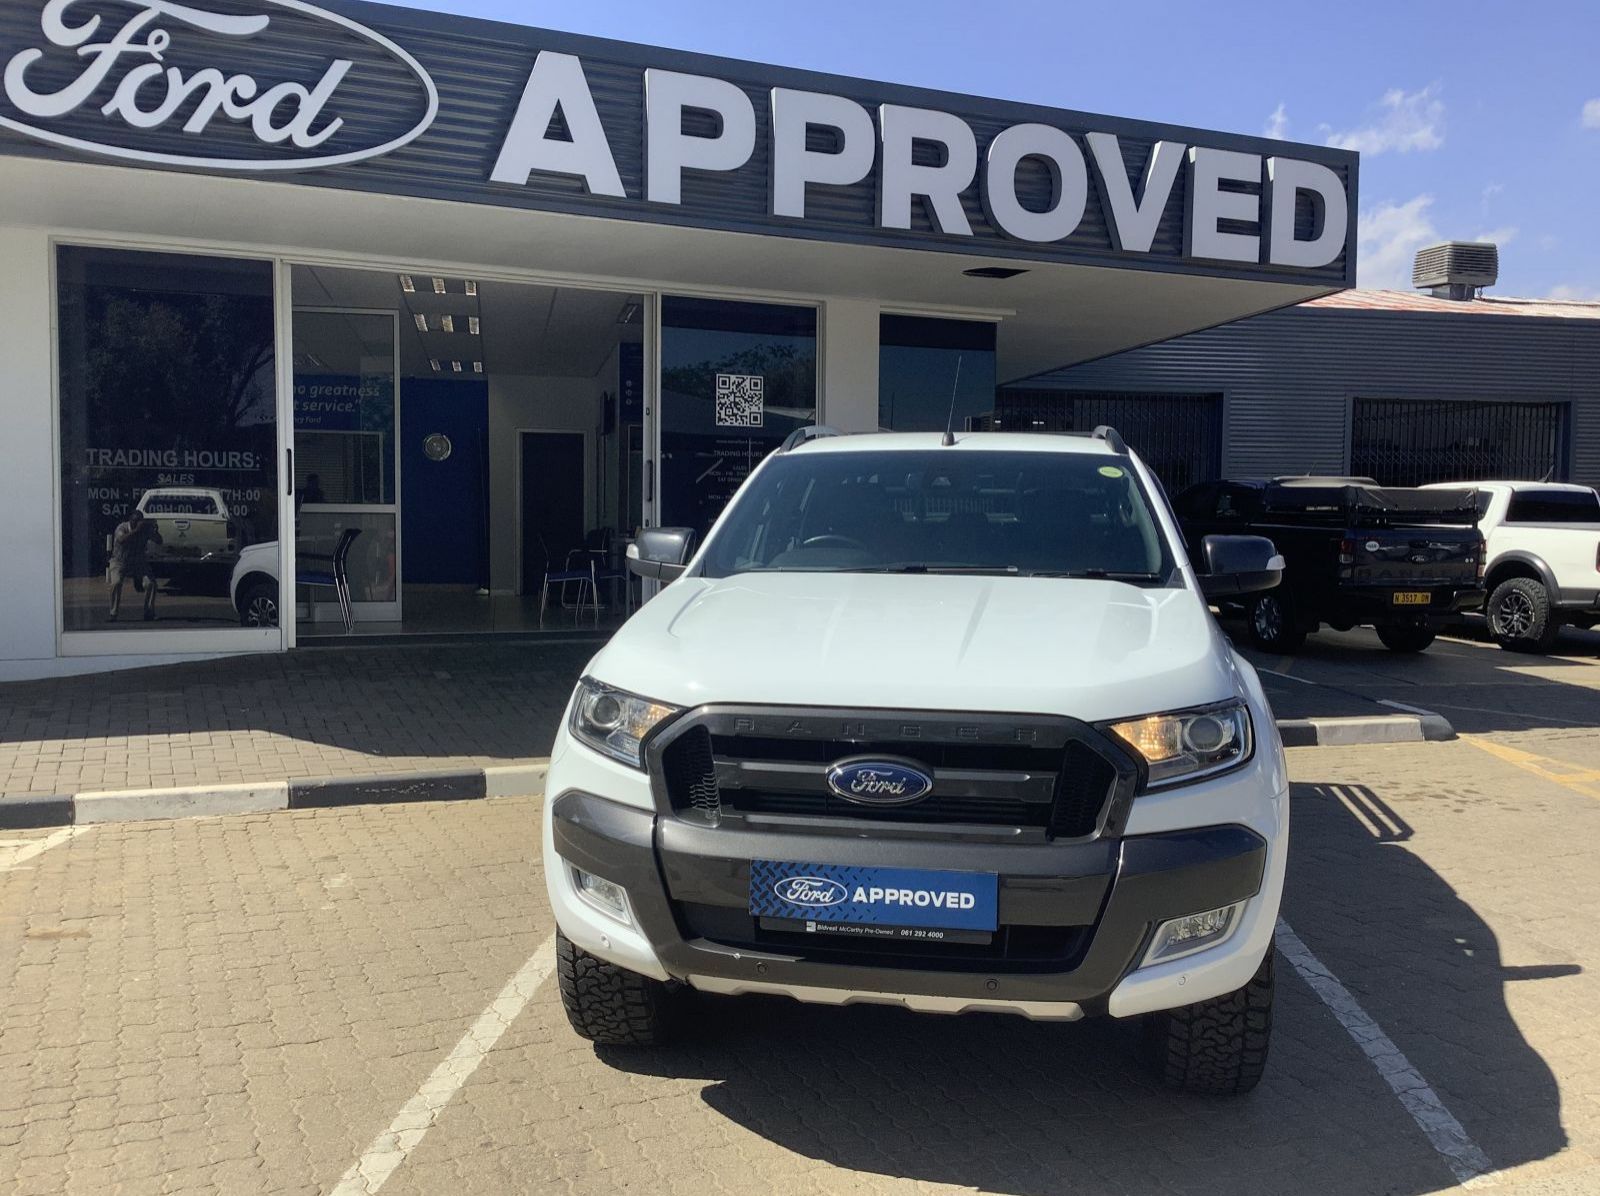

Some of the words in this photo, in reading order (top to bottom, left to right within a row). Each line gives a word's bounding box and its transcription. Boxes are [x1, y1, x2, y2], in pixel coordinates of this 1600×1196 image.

[4, 0, 353, 148] Ford
[489, 50, 1348, 268] APPROVED
[309, 384, 380, 398] greatness
[86, 448, 178, 466] TRADING
[184, 450, 261, 468] HOURS:
[713, 449, 740, 457] TRADING
[157, 472, 195, 484] SALES
[87, 487, 120, 500] MON
[102, 503, 129, 516] SAT
[850, 767, 907, 796] Ford
[786, 879, 835, 904] Ford
[852, 886, 976, 910] APPROVED
[816, 923, 838, 932] Bidvest
[839, 925, 863, 935] McCarthy
[864, 927, 894, 936] Pre-Owned
[900, 928, 913, 937] 061
[914, 929, 926, 938] 292
[927, 930, 944, 939] 4000
